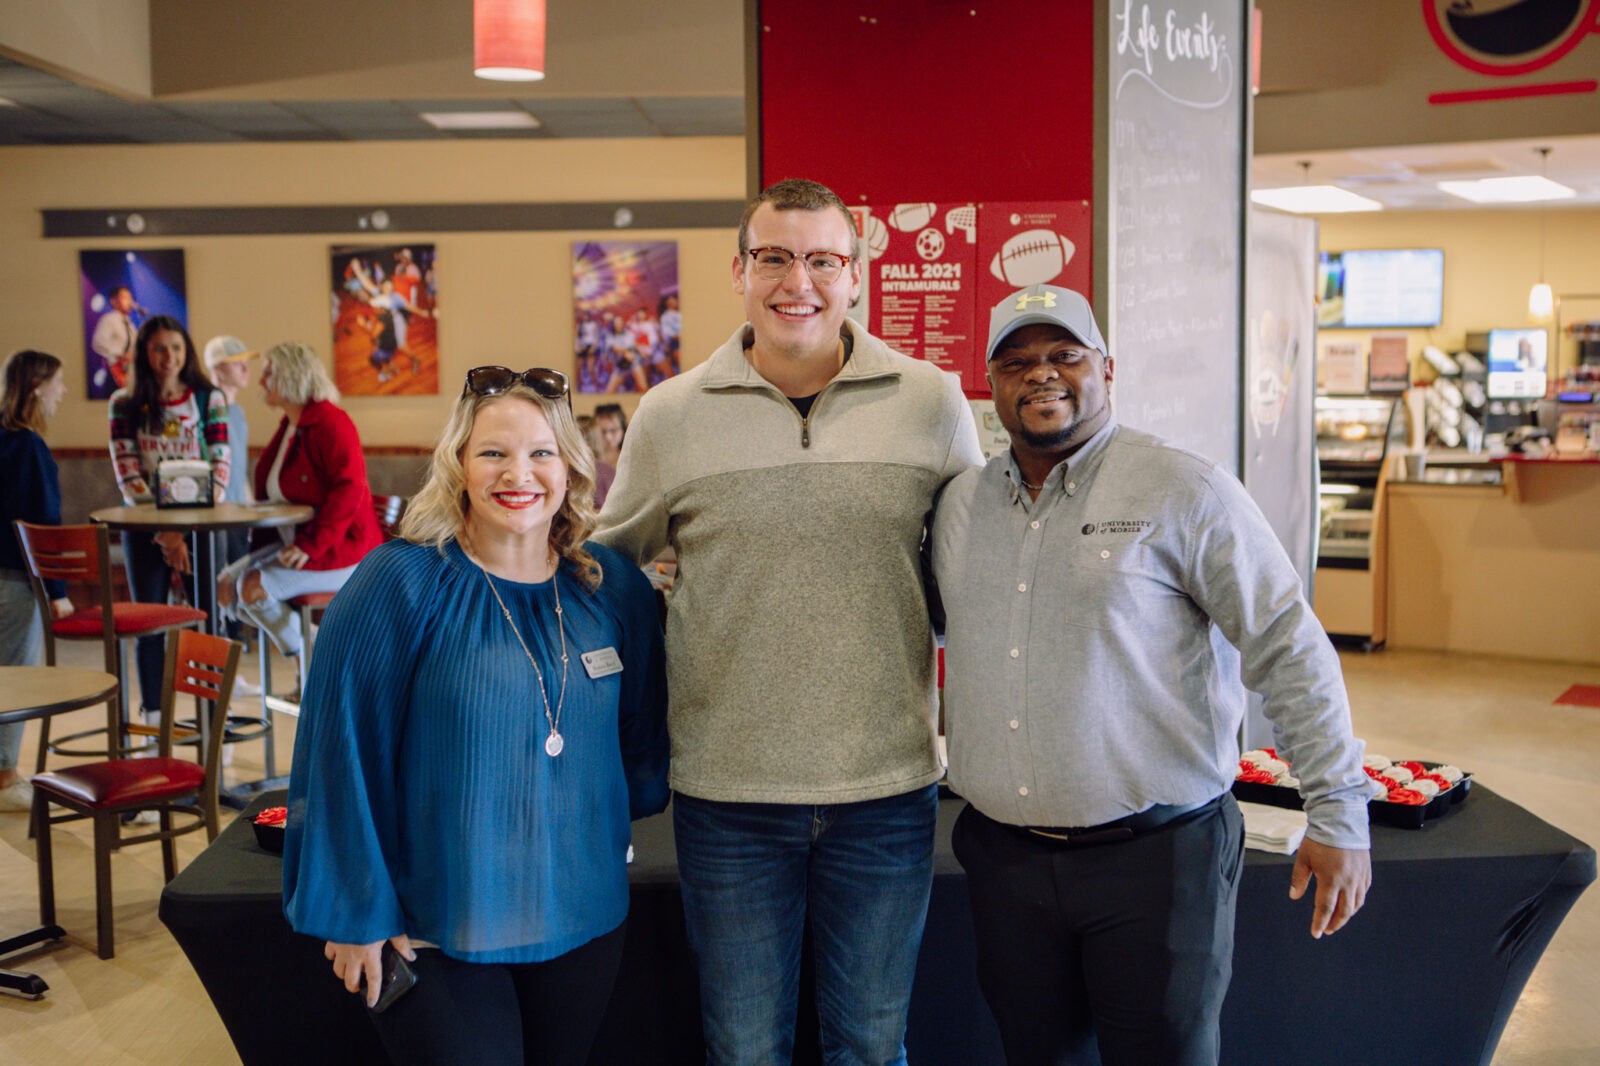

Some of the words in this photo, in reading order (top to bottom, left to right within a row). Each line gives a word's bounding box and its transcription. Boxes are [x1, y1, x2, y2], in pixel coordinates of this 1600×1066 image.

[1165, 9, 1226, 73] Events
[881, 264, 919, 279] FALL
[921, 263, 961, 279] 2021
[881, 281, 961, 292] INTRAMURALS
